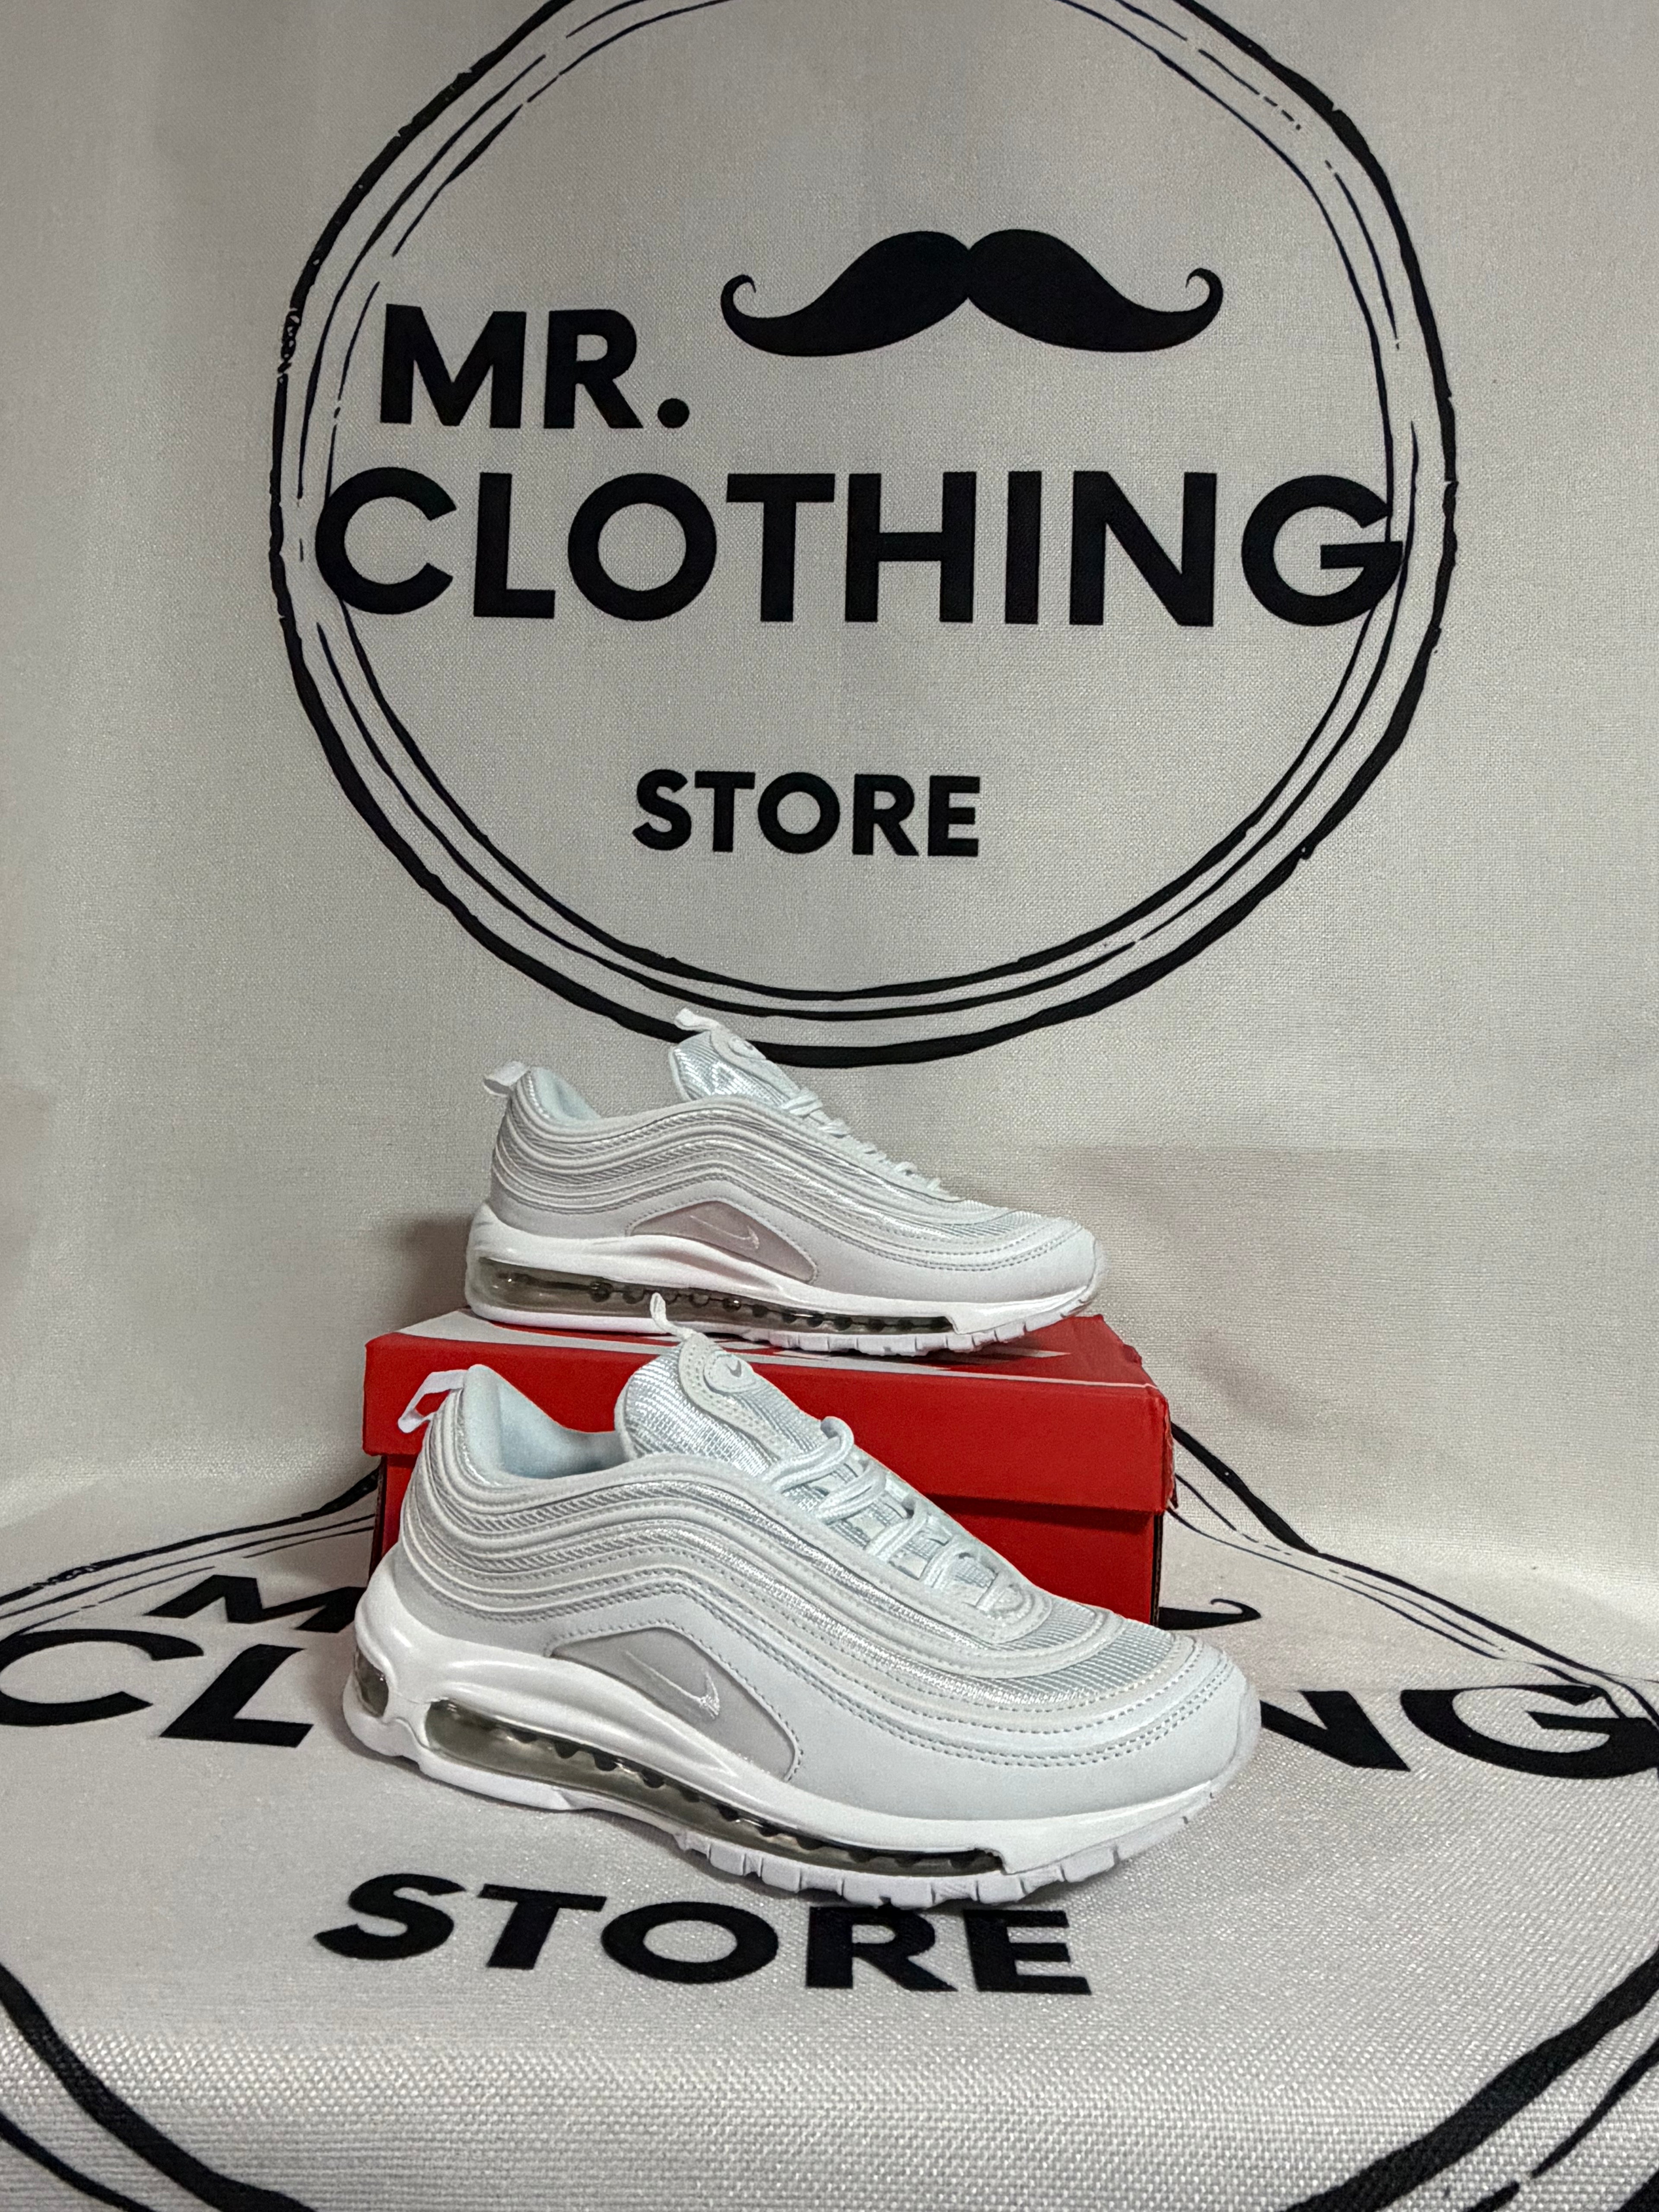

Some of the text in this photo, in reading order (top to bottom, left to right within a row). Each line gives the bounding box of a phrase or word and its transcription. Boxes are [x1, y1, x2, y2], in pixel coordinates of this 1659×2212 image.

[380, 303, 690, 429] MR.
[315, 467, 1403, 627] CLOTHING
[632, 769, 981, 857] STORE
[313, 1873, 1092, 1996] STORE
